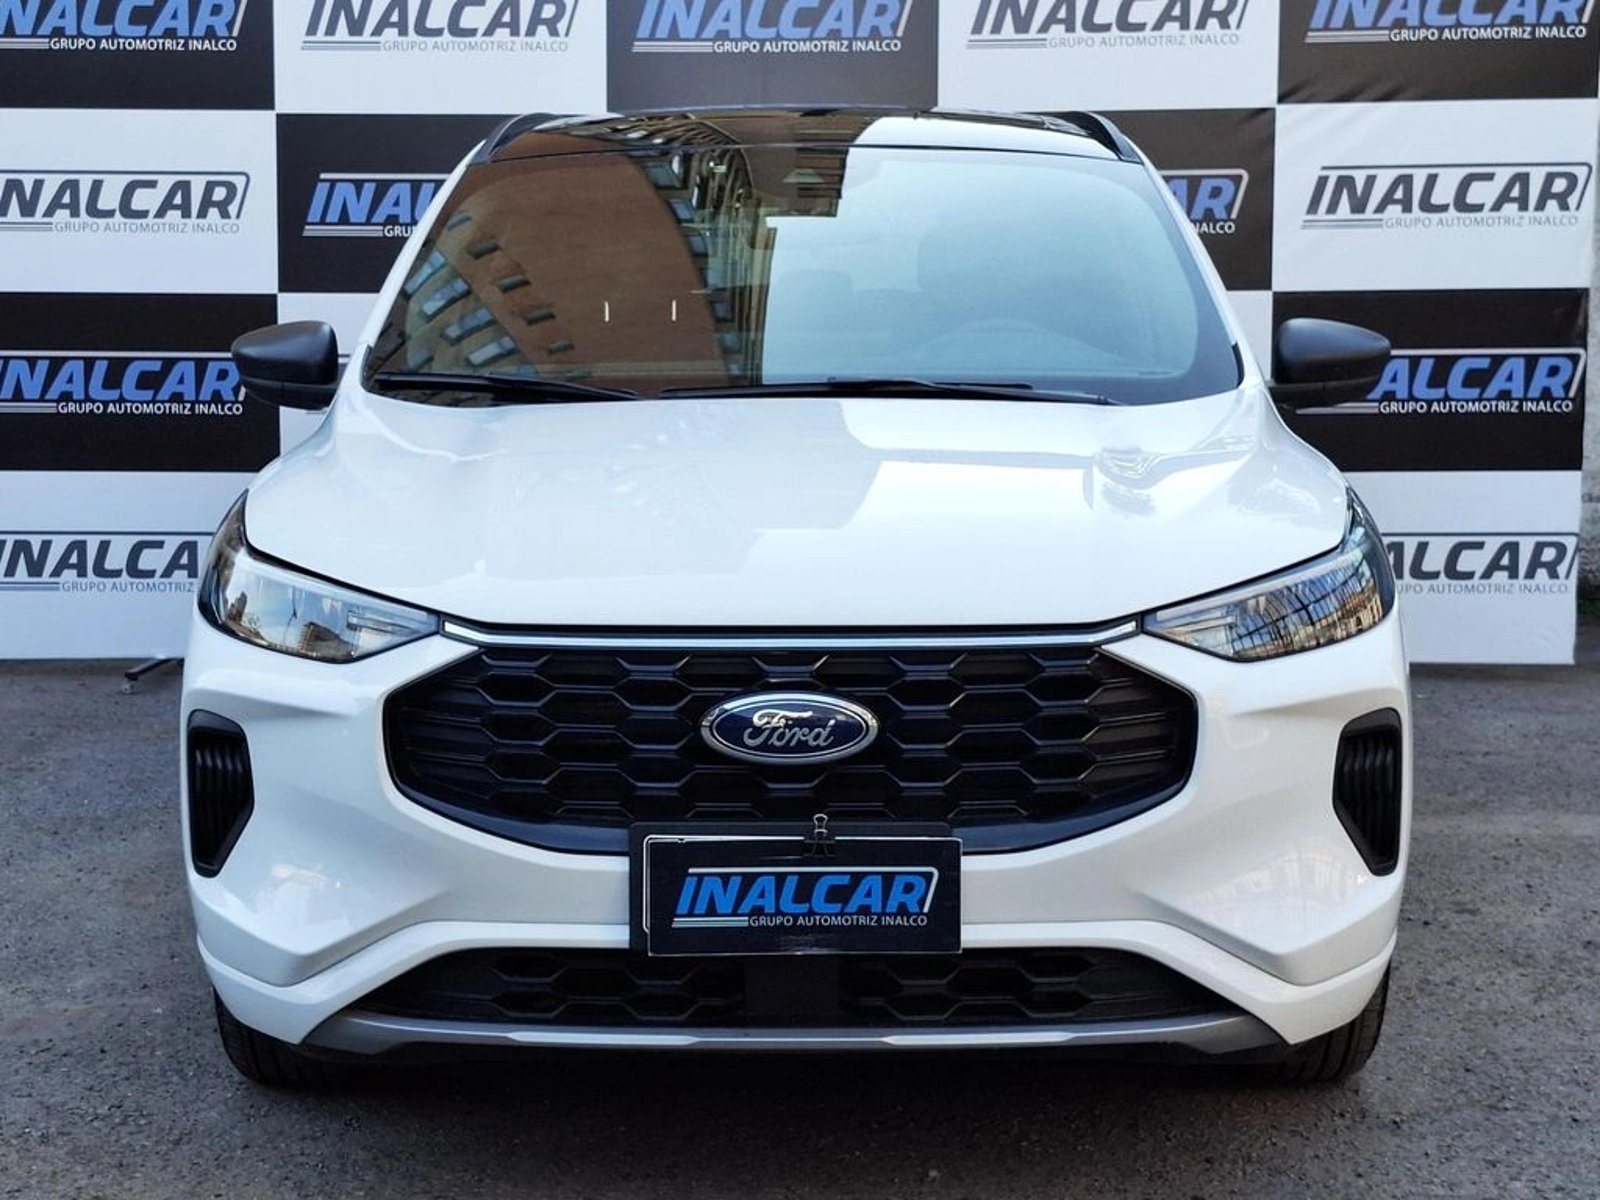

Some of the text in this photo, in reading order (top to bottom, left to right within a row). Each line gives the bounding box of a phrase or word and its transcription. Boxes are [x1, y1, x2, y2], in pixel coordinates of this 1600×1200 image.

[0, 0, 236, 36] NALCAR
[305, 0, 567, 38] INALCAR
[636, 0, 900, 39] INALCAR
[970, 0, 1238, 35] INALCAR
[1310, 0, 1581, 29] INALCAR
[51, 38, 237, 51] GRUPO AUTOMOTRIZ INALCO
[1050, 33, 1239, 48] GRUPO AUTOMOTRIZ INALCO
[1390, 25, 1587, 42] GRUPO AUTOMOTRIZ INALCO
[383, 40, 568, 52] GRUPO AUTOMOTRIZ INALCO
[714, 40, 901, 53] GRUPO AUTOMOTRIZ INALCO
[0, 178, 238, 220] NALCAR
[1305, 171, 1579, 215] INALCAR
[54, 222, 240, 235] GRUPO AUTOMOTRIZ INALCO
[384, 226, 415, 237] GRU
[1385, 214, 1579, 229] GRUPO AUTOMOTRIZ INALCO
[0, 359, 241, 400] NALCAR
[1366, 356, 1574, 400] ALCAR
[58, 402, 243, 415] GRUPO AUTOMOTRIZ INALCO
[1380, 400, 1573, 414] GRUPO AUTOMOTRIZ INALCO
[0, 539, 200, 579] NALCA
[1386, 541, 1568, 580] ALCAR
[61, 581, 196, 593] GRUPO AUTOMOTRIZ
[1397, 582, 1568, 594] UPO AUTOMOTRIZ INALCO
[743, 709, 836, 747] Ford
[675, 875, 927, 915] INALCAR
[750, 915, 928, 927] GRUPO AUTOMOTRIZ INALCO
